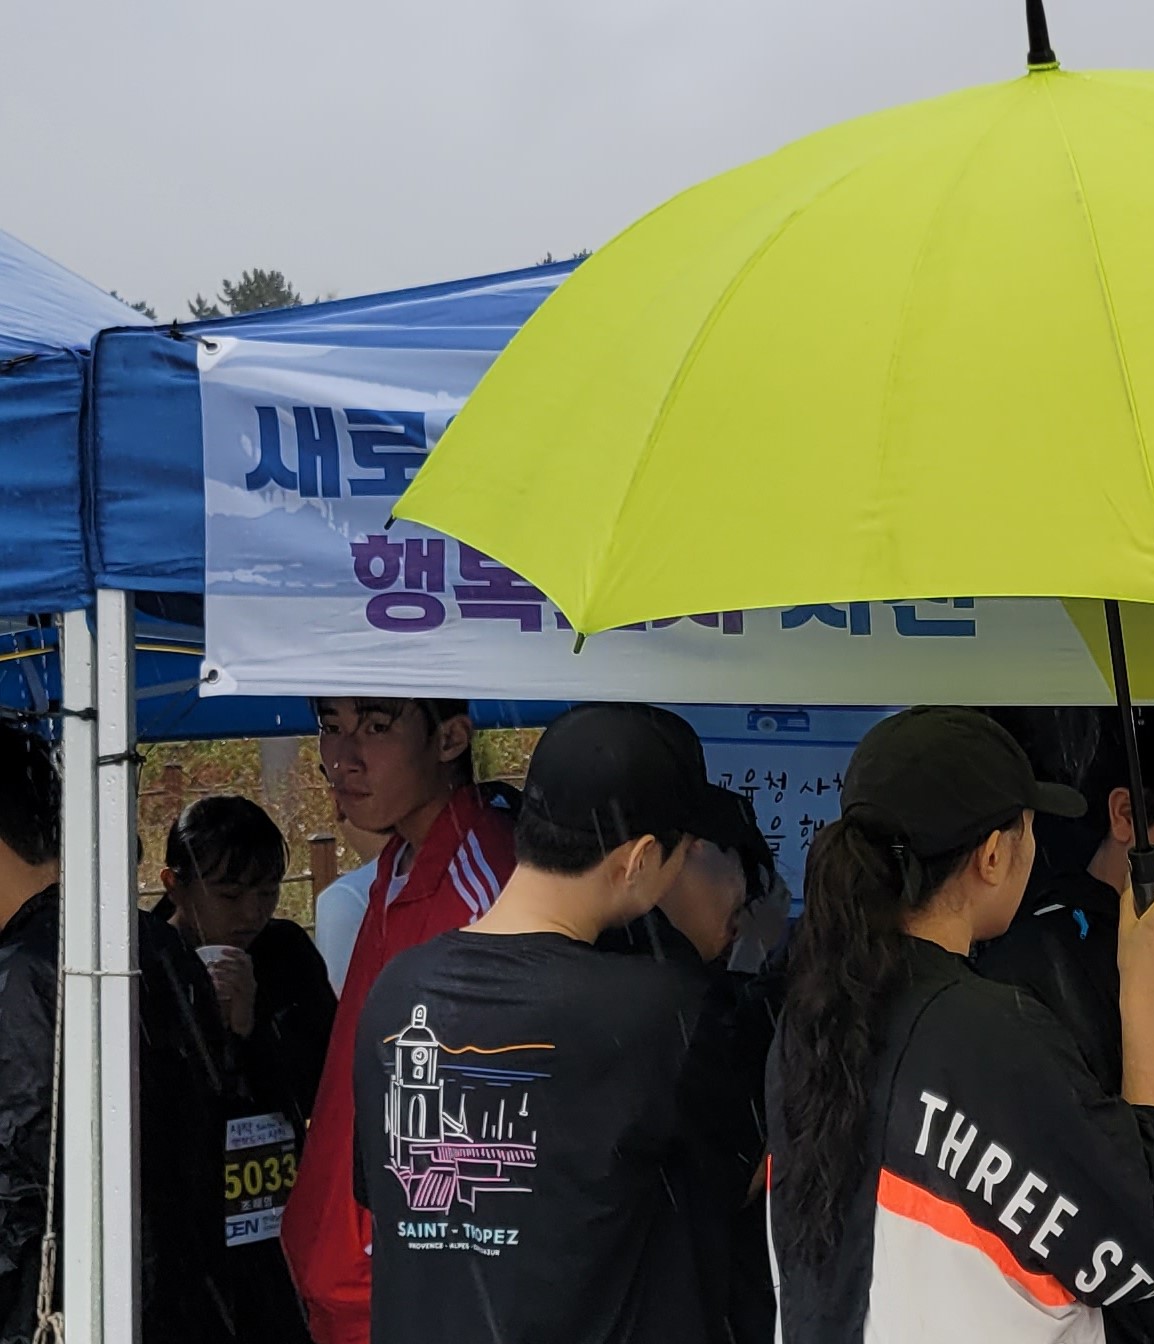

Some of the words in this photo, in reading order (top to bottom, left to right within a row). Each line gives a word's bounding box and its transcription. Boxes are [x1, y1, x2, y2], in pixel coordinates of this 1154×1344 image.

[245, 406, 458, 498] 새로
[225, 1153, 297, 1200] 5033
[914, 1090, 1079, 1258] THREE
[398, 1221, 449, 1238] SAINT
